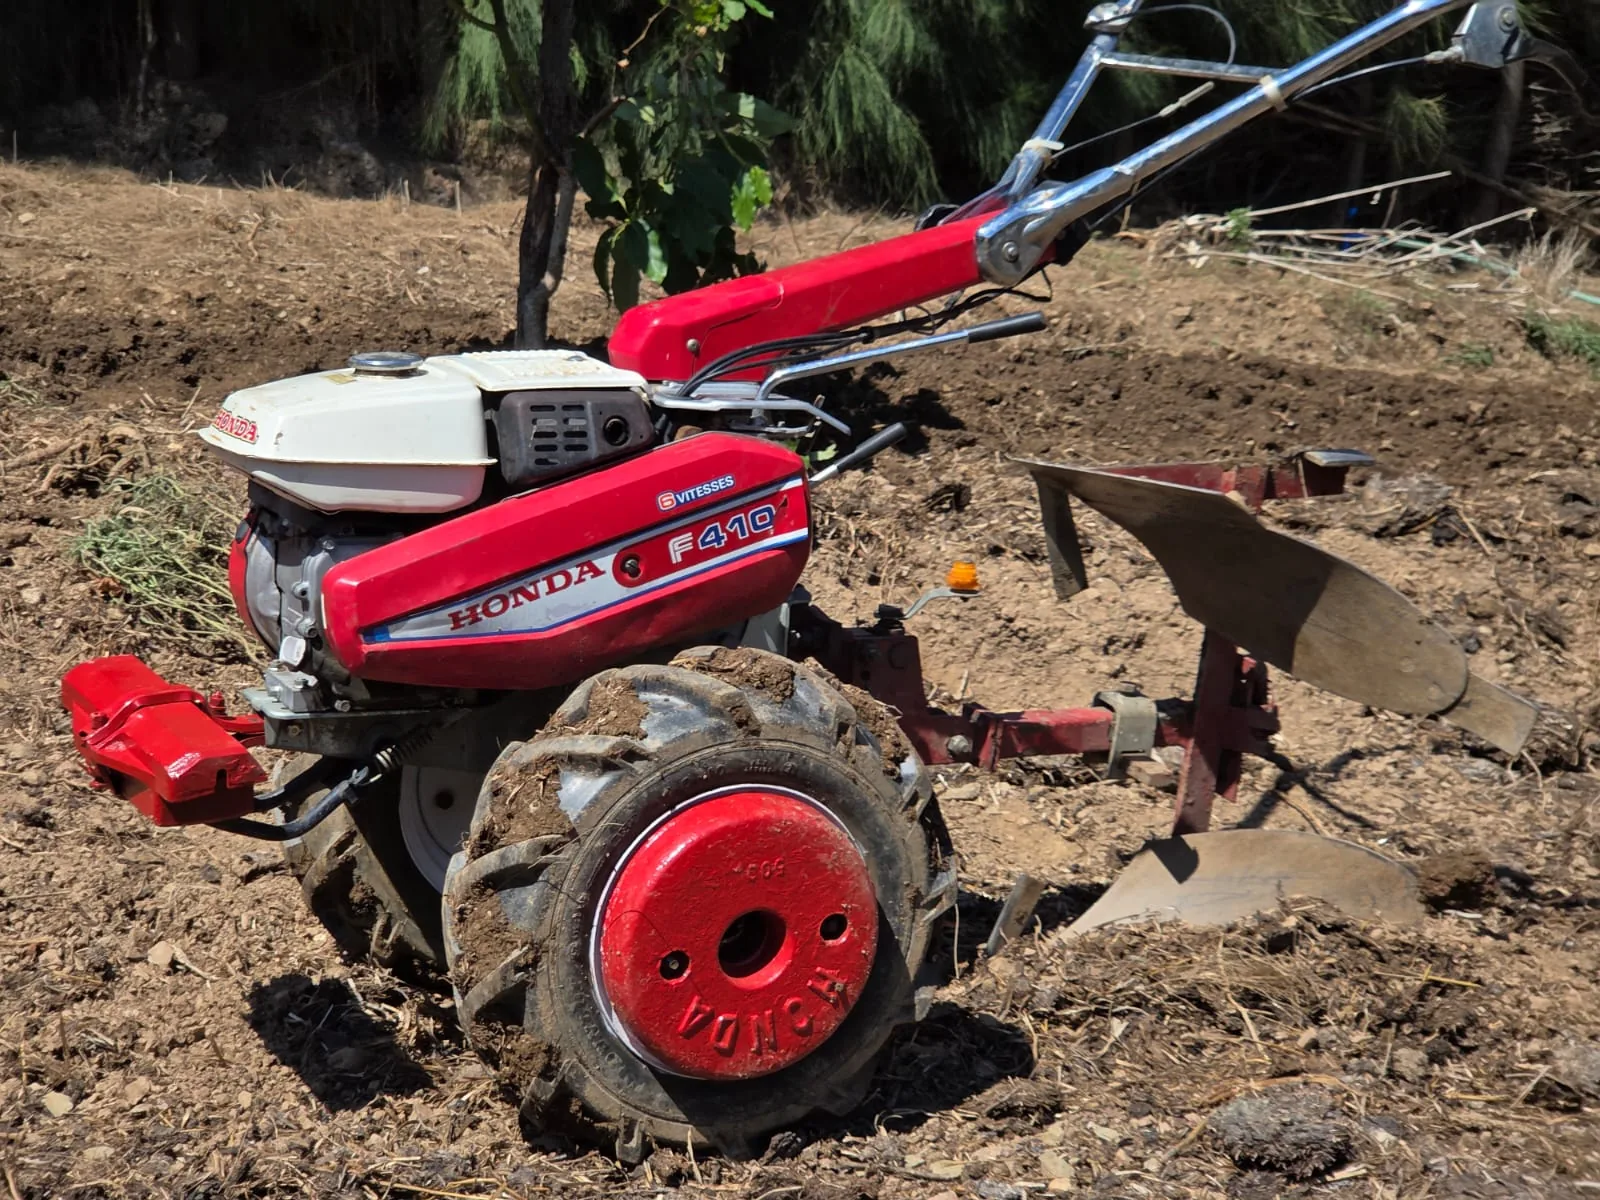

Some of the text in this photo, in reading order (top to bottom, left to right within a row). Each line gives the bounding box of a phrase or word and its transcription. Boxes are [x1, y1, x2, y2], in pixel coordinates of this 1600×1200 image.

[213, 409, 258, 441] HONDA
[675, 475, 735, 504] VITESSES
[668, 503, 776, 565] F410
[447, 559, 607, 632] HONDA
[676, 965, 852, 1058] HONDA
